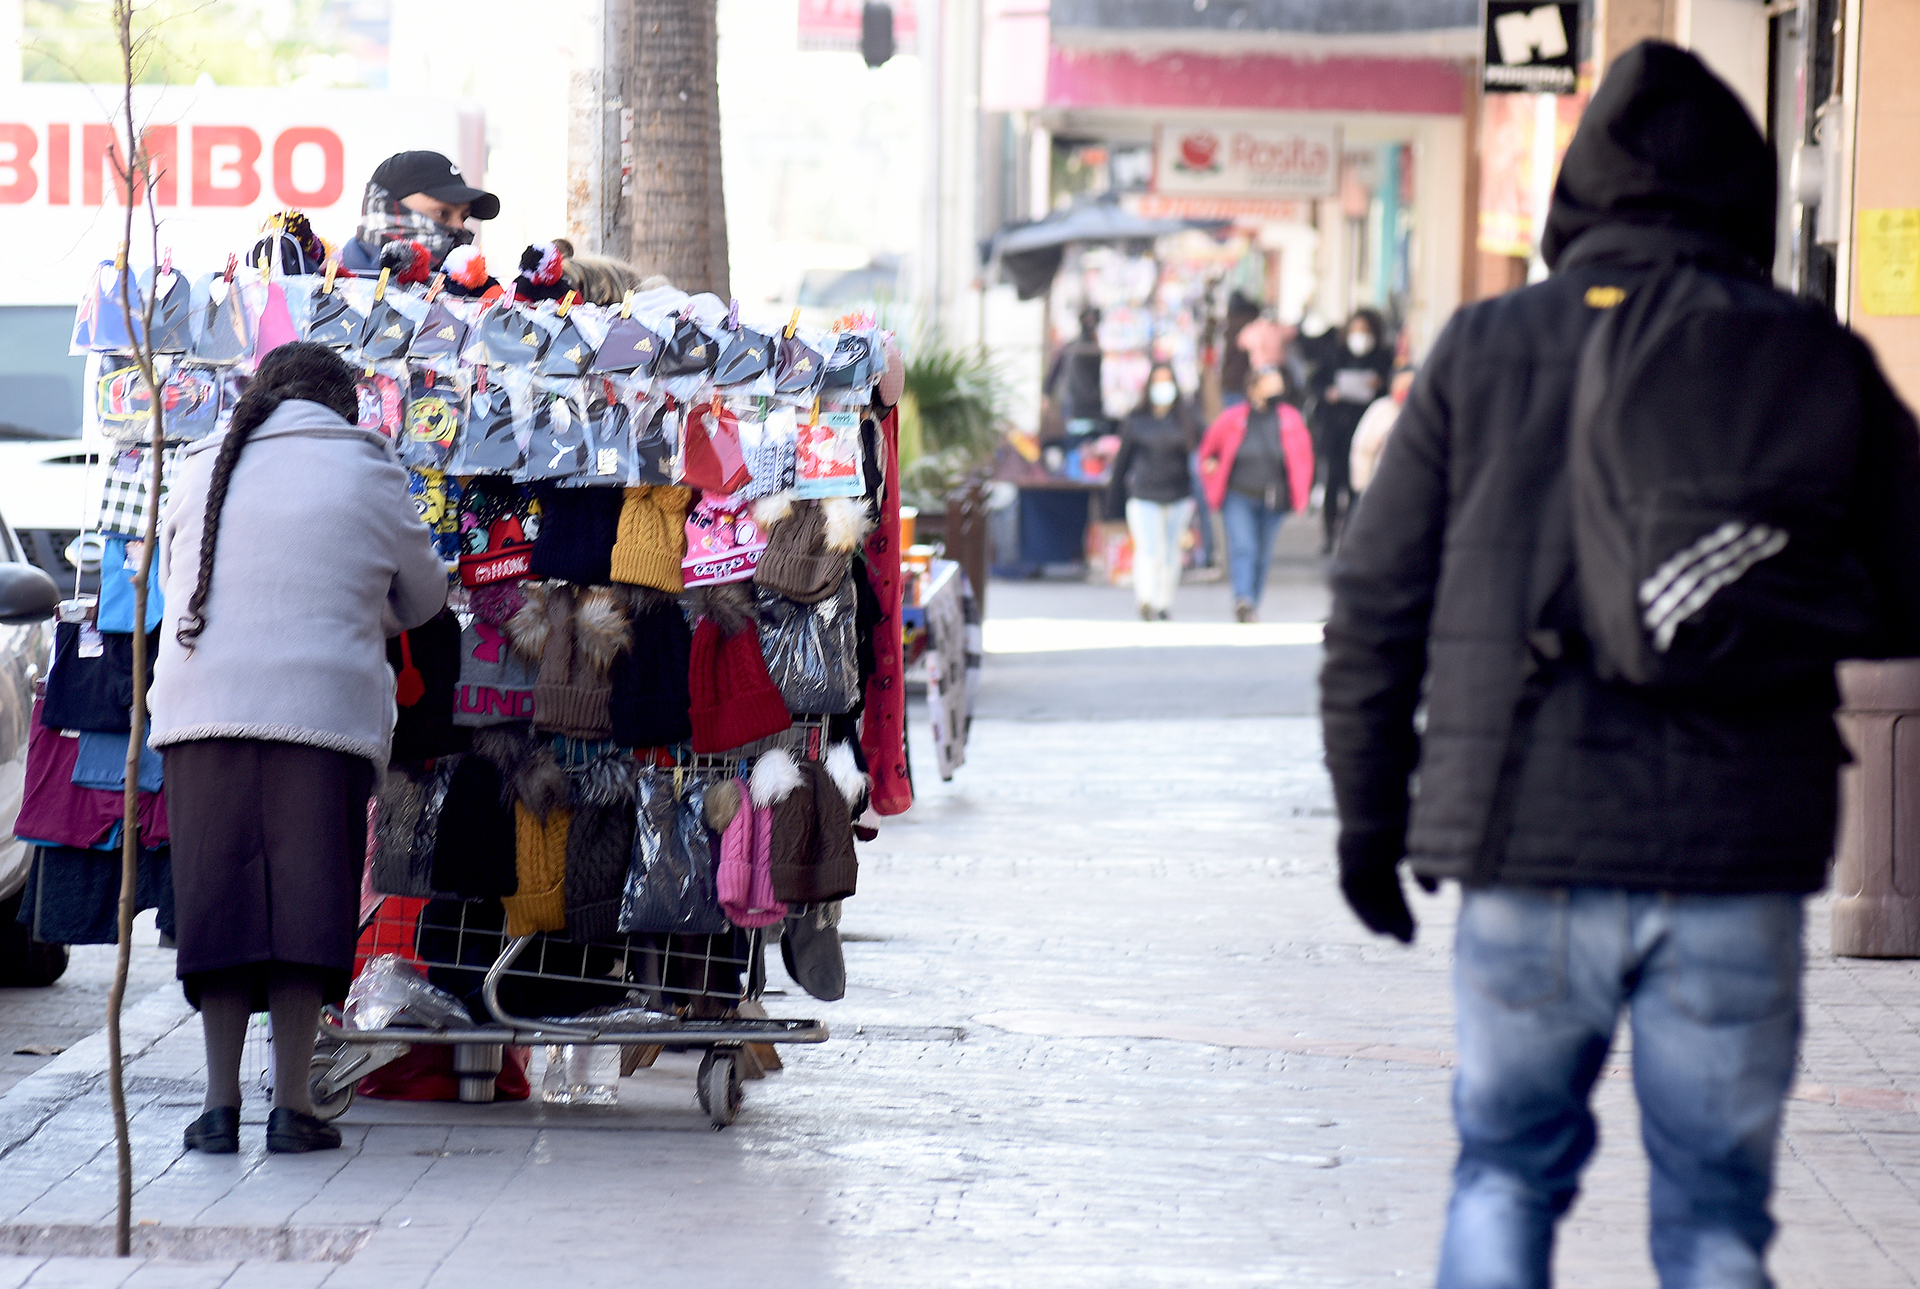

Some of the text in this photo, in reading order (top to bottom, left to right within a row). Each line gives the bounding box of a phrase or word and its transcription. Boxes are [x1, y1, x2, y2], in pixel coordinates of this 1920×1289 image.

[0, 123, 344, 208] BIMBO
[1230, 132, 1330, 176] Rosita
[461, 685, 535, 717] UND
